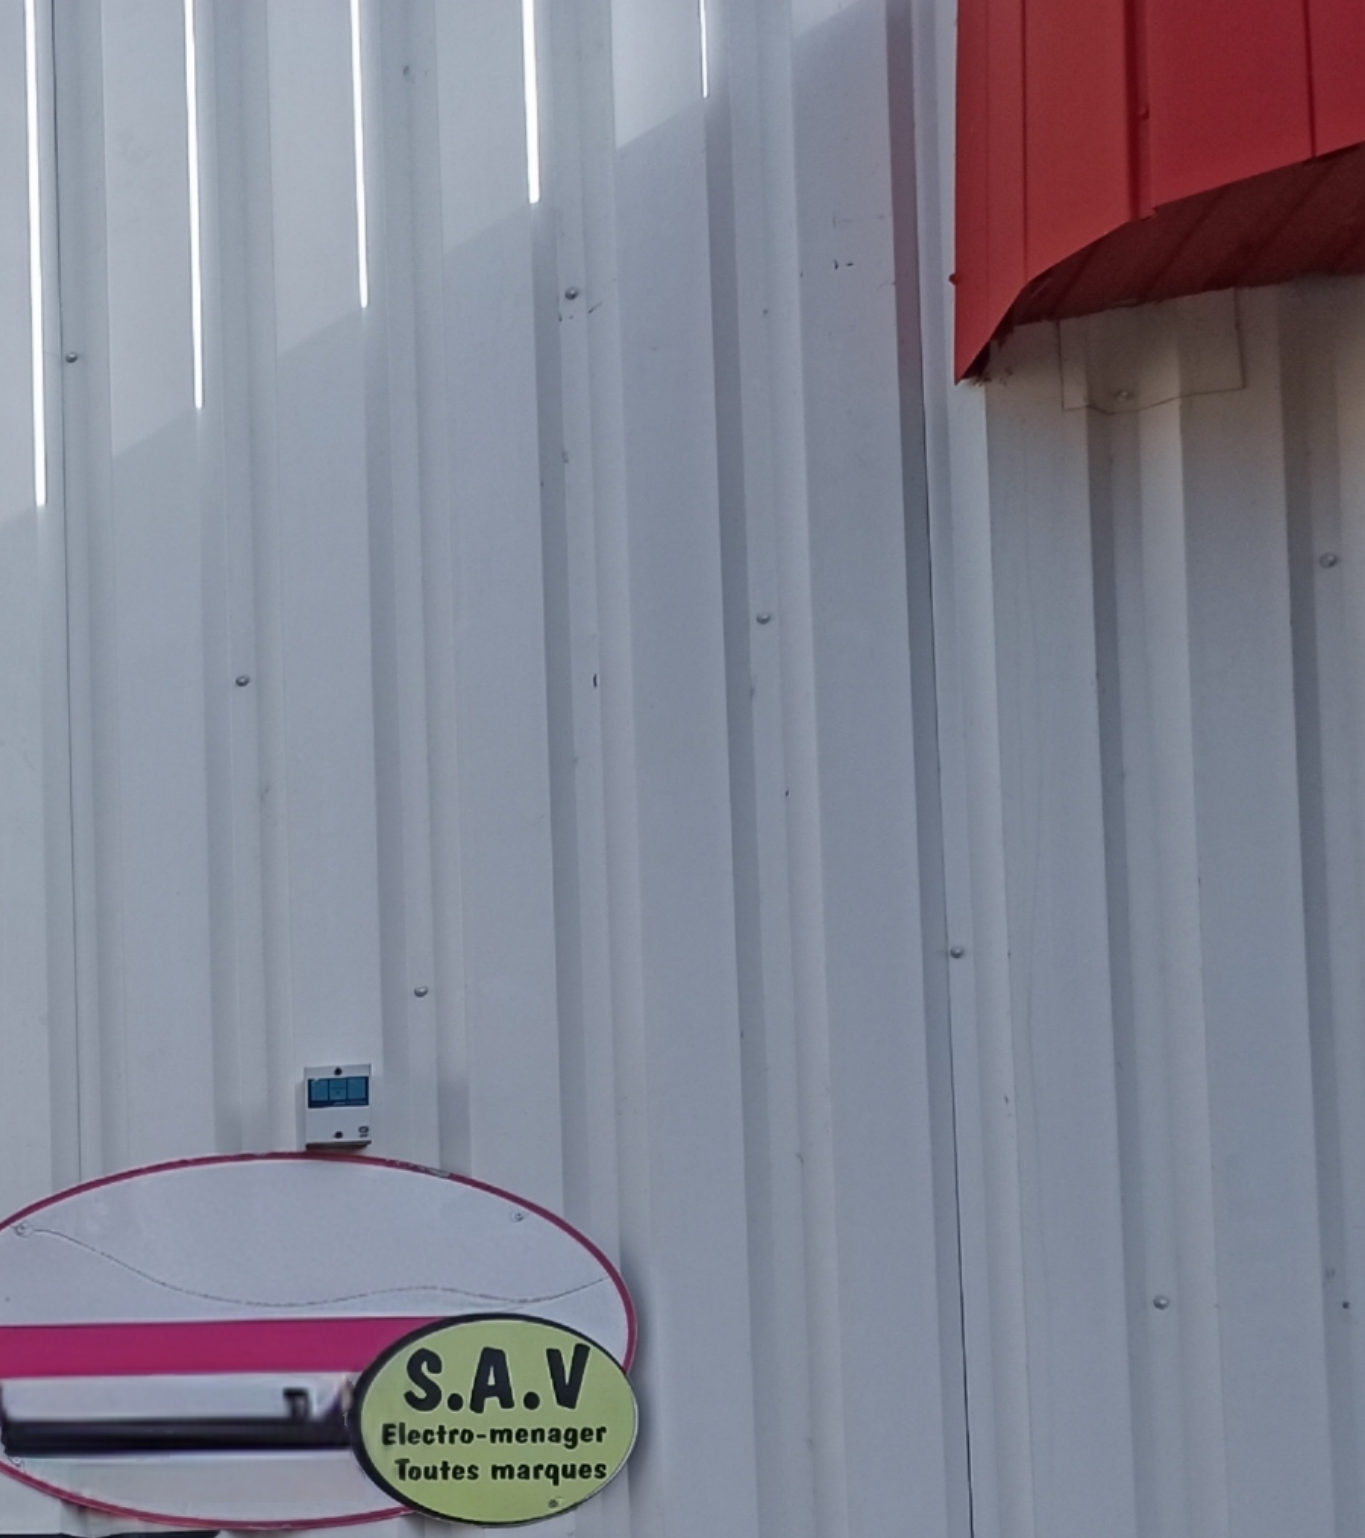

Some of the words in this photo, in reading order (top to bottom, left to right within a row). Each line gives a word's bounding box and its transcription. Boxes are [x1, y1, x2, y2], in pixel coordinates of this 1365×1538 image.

[403, 1343, 591, 1414] S.A.V
[381, 1422, 608, 1450] Electro-menager
[394, 1458, 480, 1481] Toutes
[491, 1463, 608, 1486] marques
